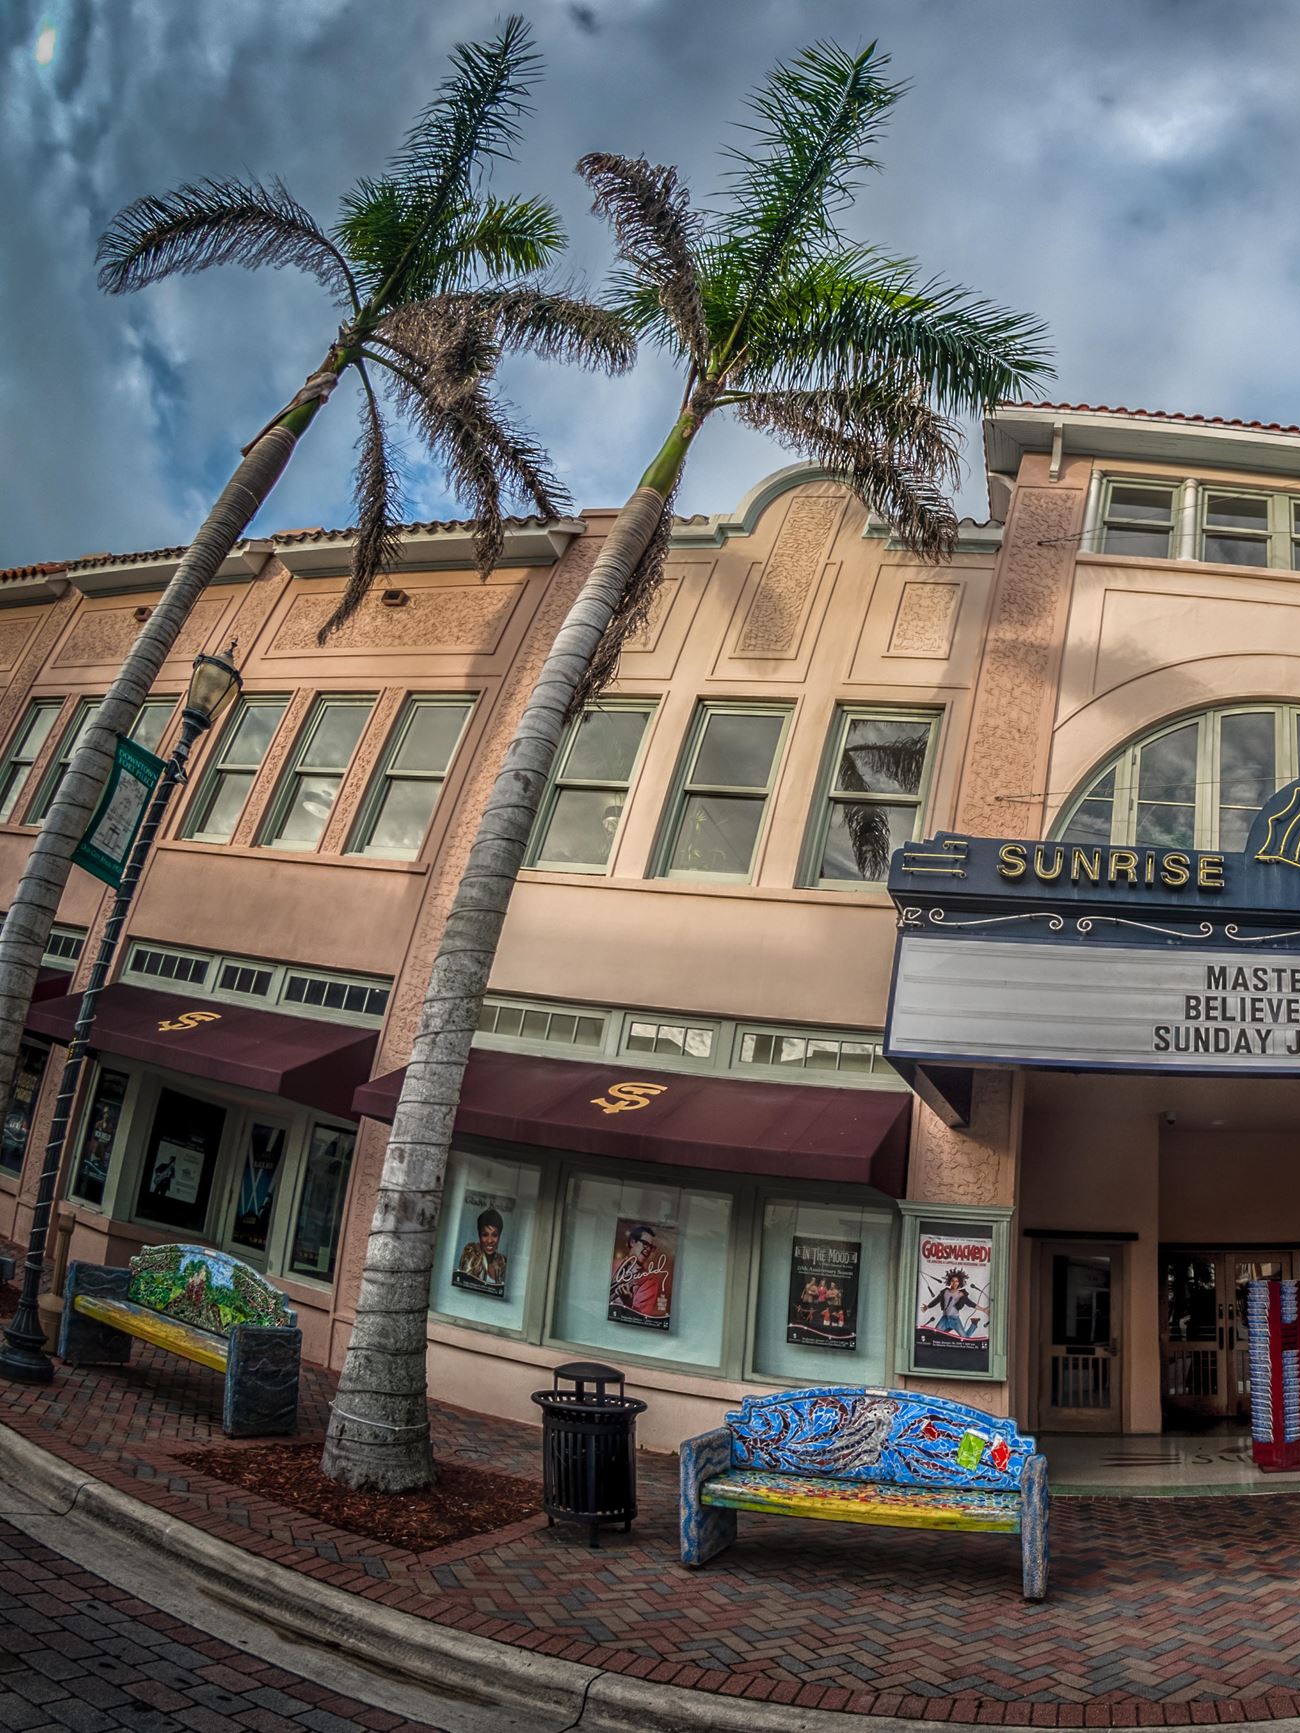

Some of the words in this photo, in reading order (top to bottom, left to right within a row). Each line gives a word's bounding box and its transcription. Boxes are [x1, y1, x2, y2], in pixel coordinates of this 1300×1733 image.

[118, 749, 158, 781] DOWNTOWN
[996, 842, 1225, 888] SUNRISE
[1184, 995, 1300, 1024] BELIEVE
[1153, 1025, 1272, 1054] SUNDAY
[615, 1254, 669, 1292] Buddy
